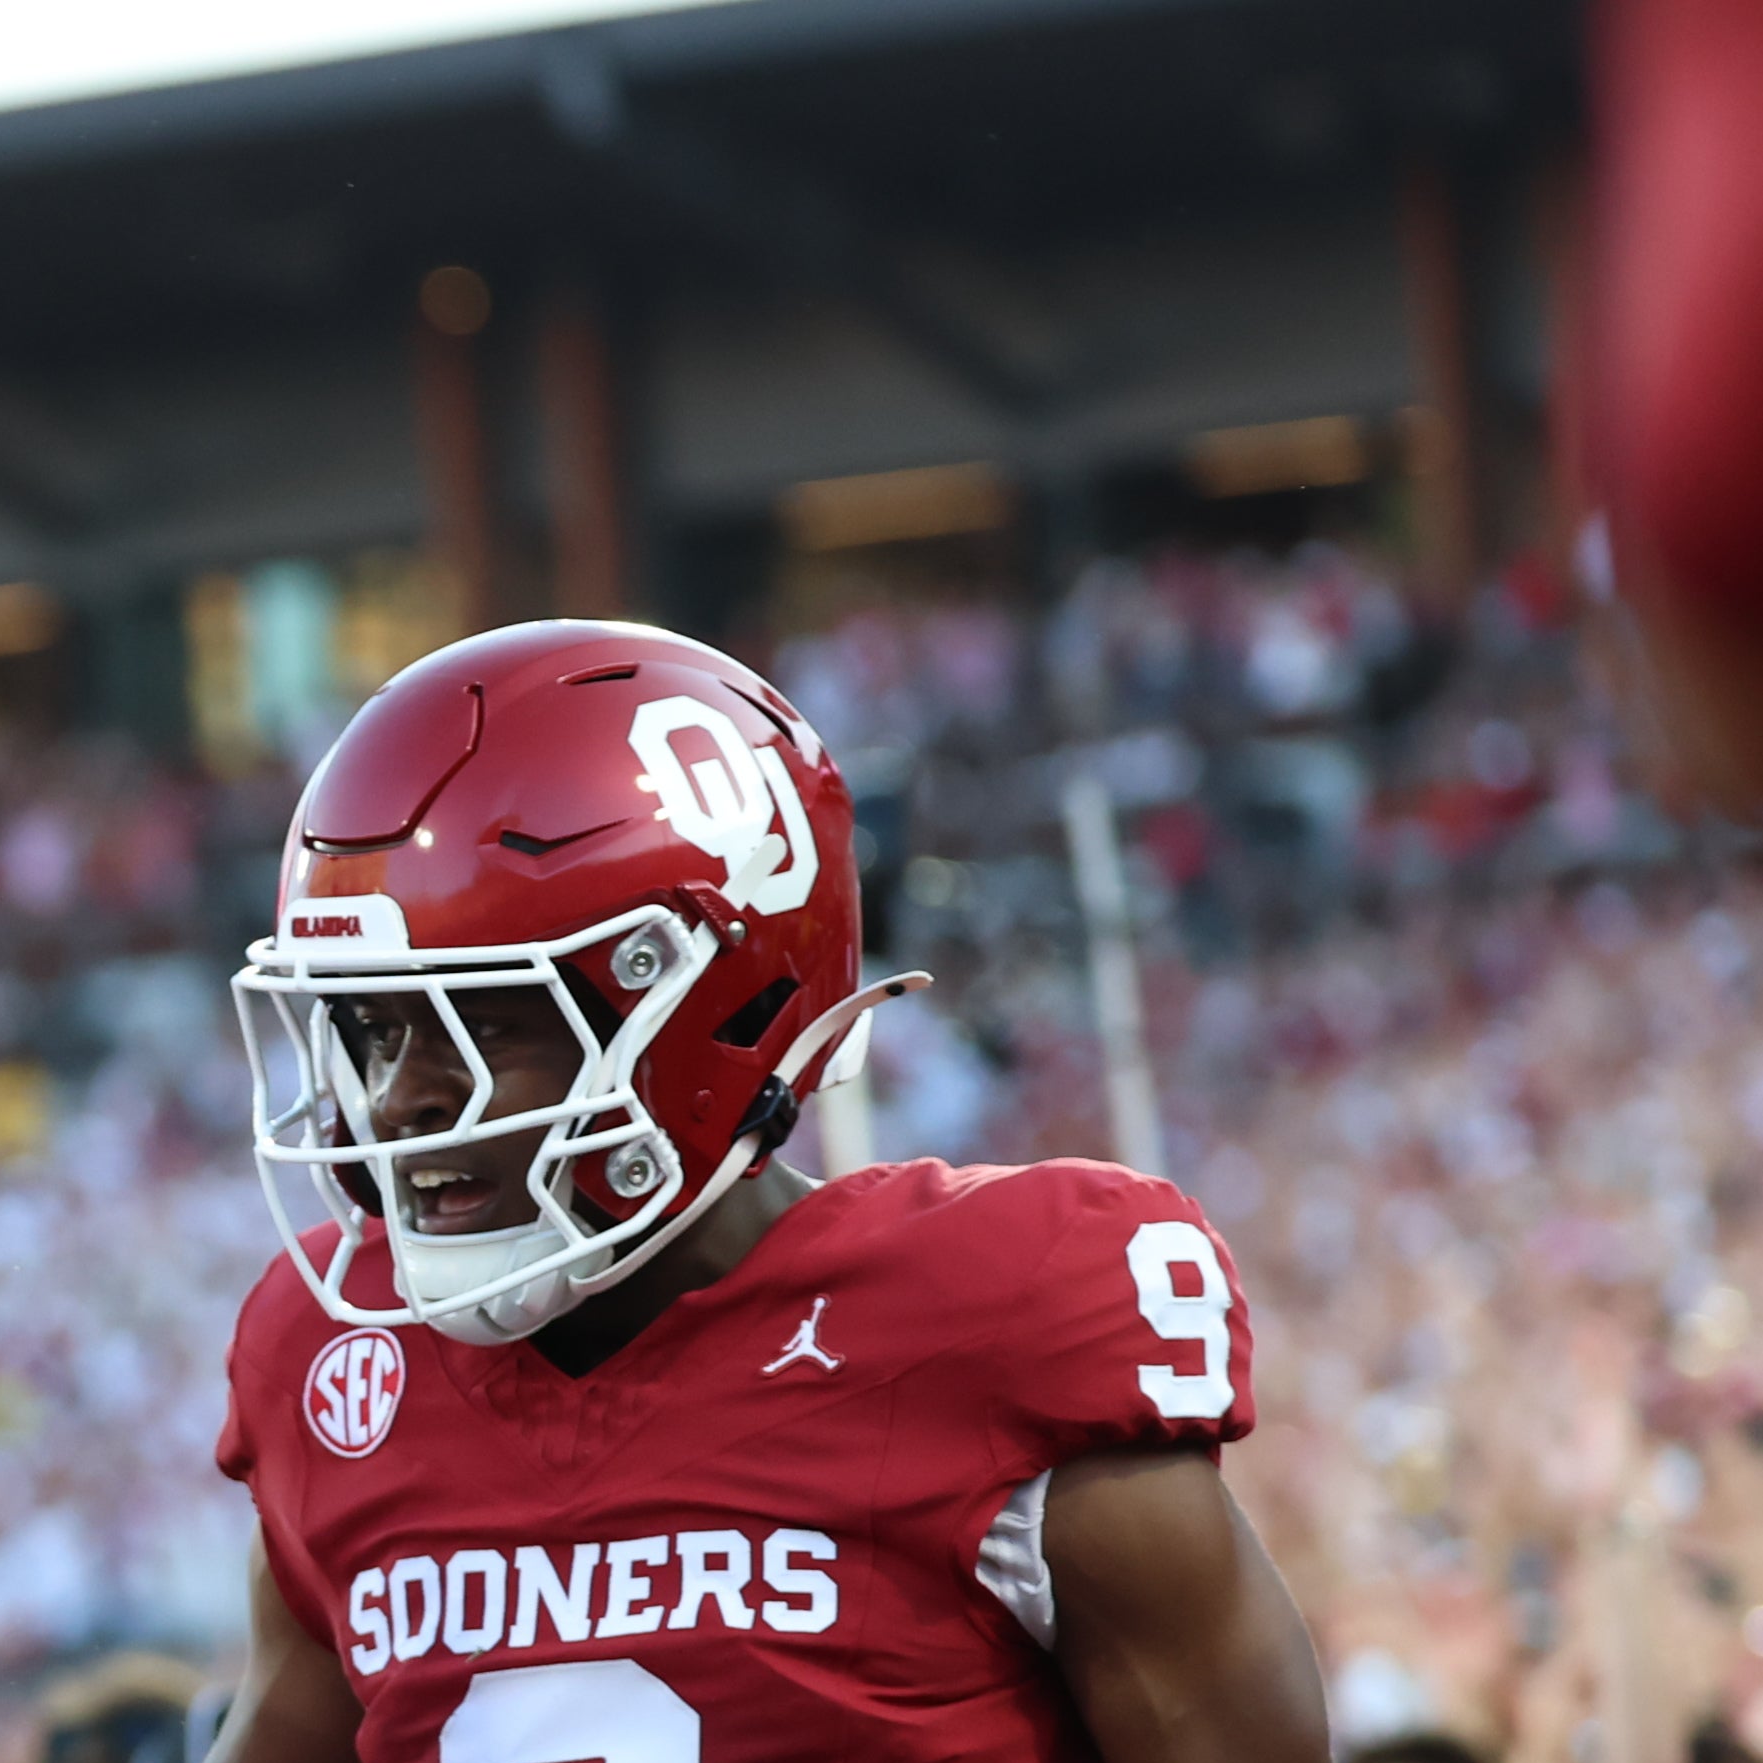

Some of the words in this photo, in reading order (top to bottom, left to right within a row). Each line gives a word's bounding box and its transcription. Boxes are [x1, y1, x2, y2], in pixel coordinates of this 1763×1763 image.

[314, 1336, 398, 1447] SEC
[1126, 1221, 1233, 1418] 9
[349, 1528, 838, 1676] SOONERS
